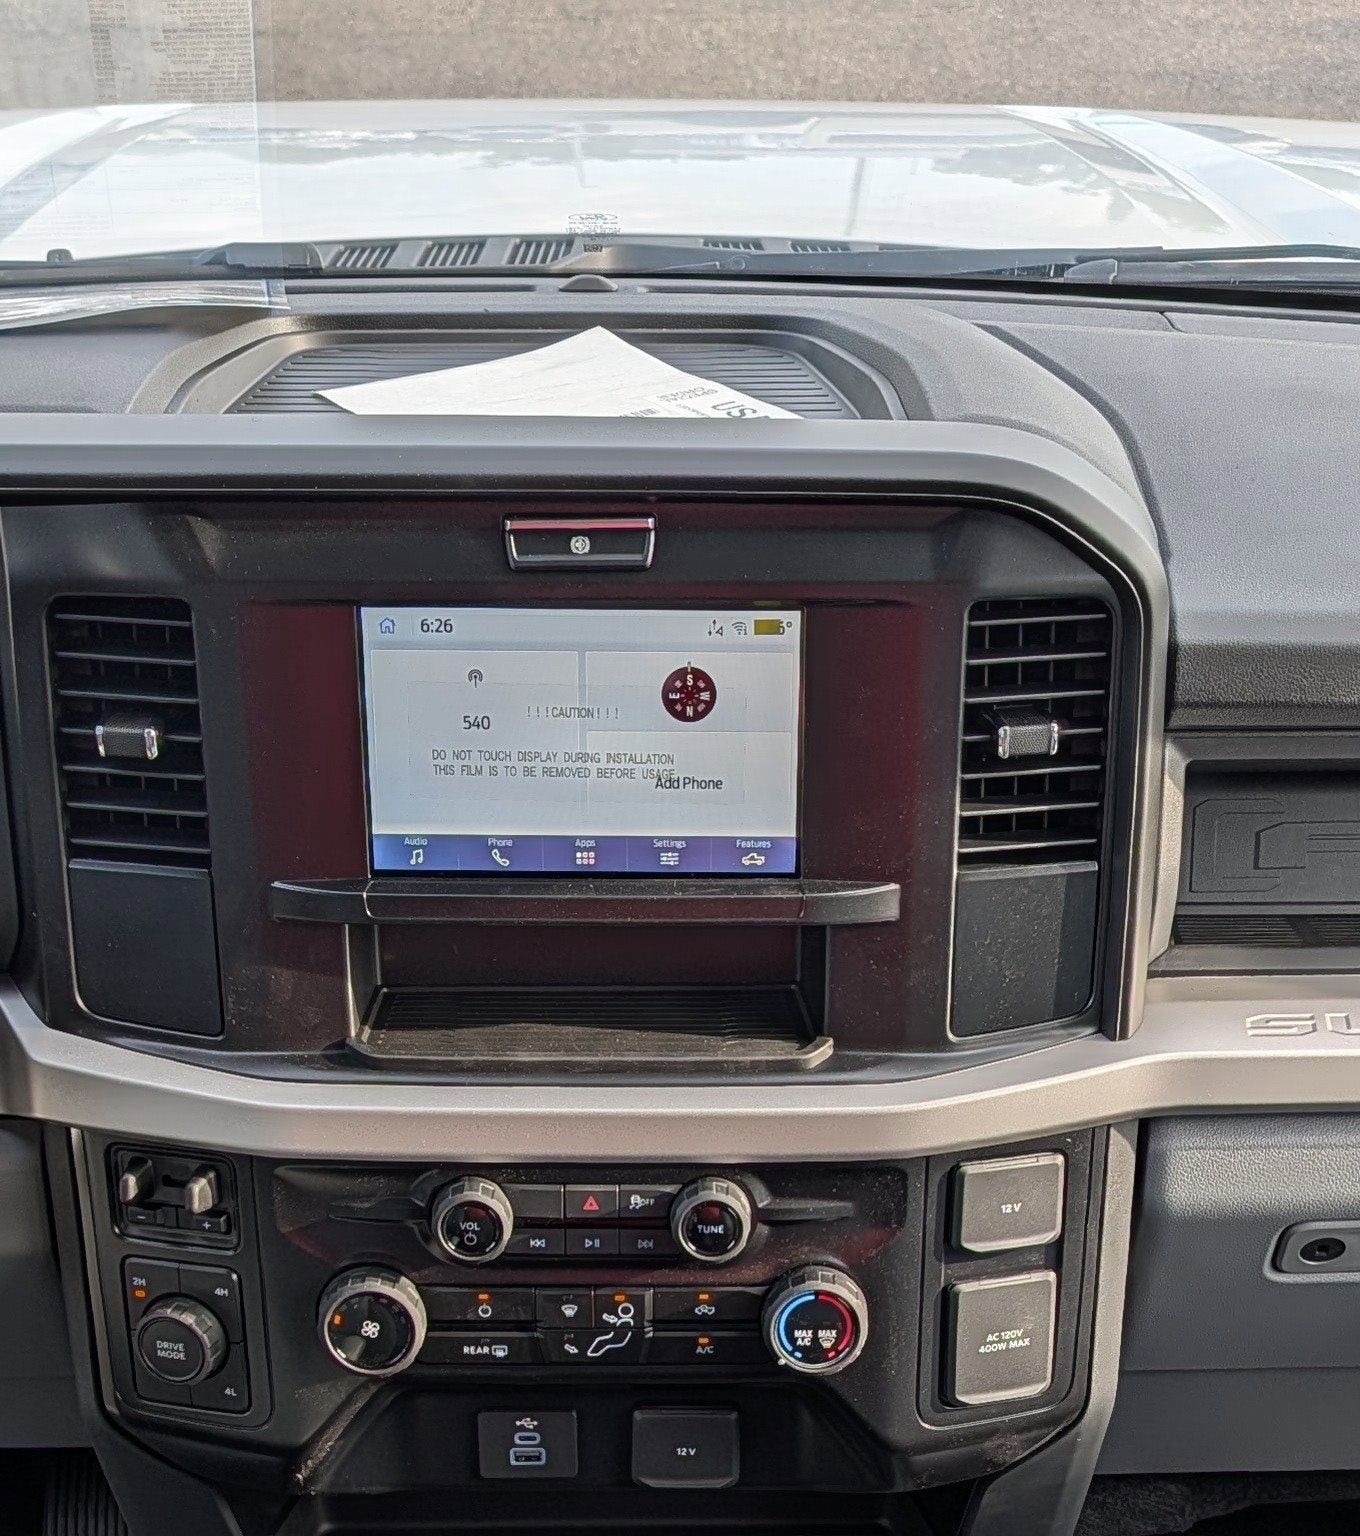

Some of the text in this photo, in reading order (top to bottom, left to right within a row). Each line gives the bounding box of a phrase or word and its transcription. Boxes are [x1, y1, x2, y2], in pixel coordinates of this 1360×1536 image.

[420, 618, 453, 634] 6:26
[463, 716, 491, 730] 540
[432, 749, 675, 765] DO NOT TOUCH DISPLAY DURING INSTALLATION
[433, 764, 455, 776] THIS
[461, 765, 483, 776] FILM
[489, 766, 498, 776] IS
[504, 766, 517, 777] TO
[523, 766, 536, 777] BE
[542, 767, 591, 778] REMOVED
[596, 768, 636, 779] BEFORE
[655, 777, 723, 790] Add Phone
[404, 837, 428, 847] Audio
[488, 838, 513, 847] Phone
[575, 838, 596, 849] Apps
[653, 839, 687, 850] Settings
[736, 839, 771, 850] Features
[459, 1222, 480, 1231] VOL
[697, 1225, 724, 1234] TUNE
[133, 1277, 146, 1286] 2H
[214, 1288, 228, 1297] 4H
[794, 1330, 813, 1338] MAX
[818, 1330, 837, 1338] MAX
[986, 1328, 1023, 1342] AC 120V
[156, 1340, 186, 1351] DRIVE
[797, 1338, 811, 1346] A/C
[978, 1338, 1031, 1353] 400W MAX
[157, 1350, 186, 1360] MODE
[463, 1346, 489, 1355] REAR
[696, 1346, 714, 1354] A/C
[224, 1387, 237, 1397] 4L
